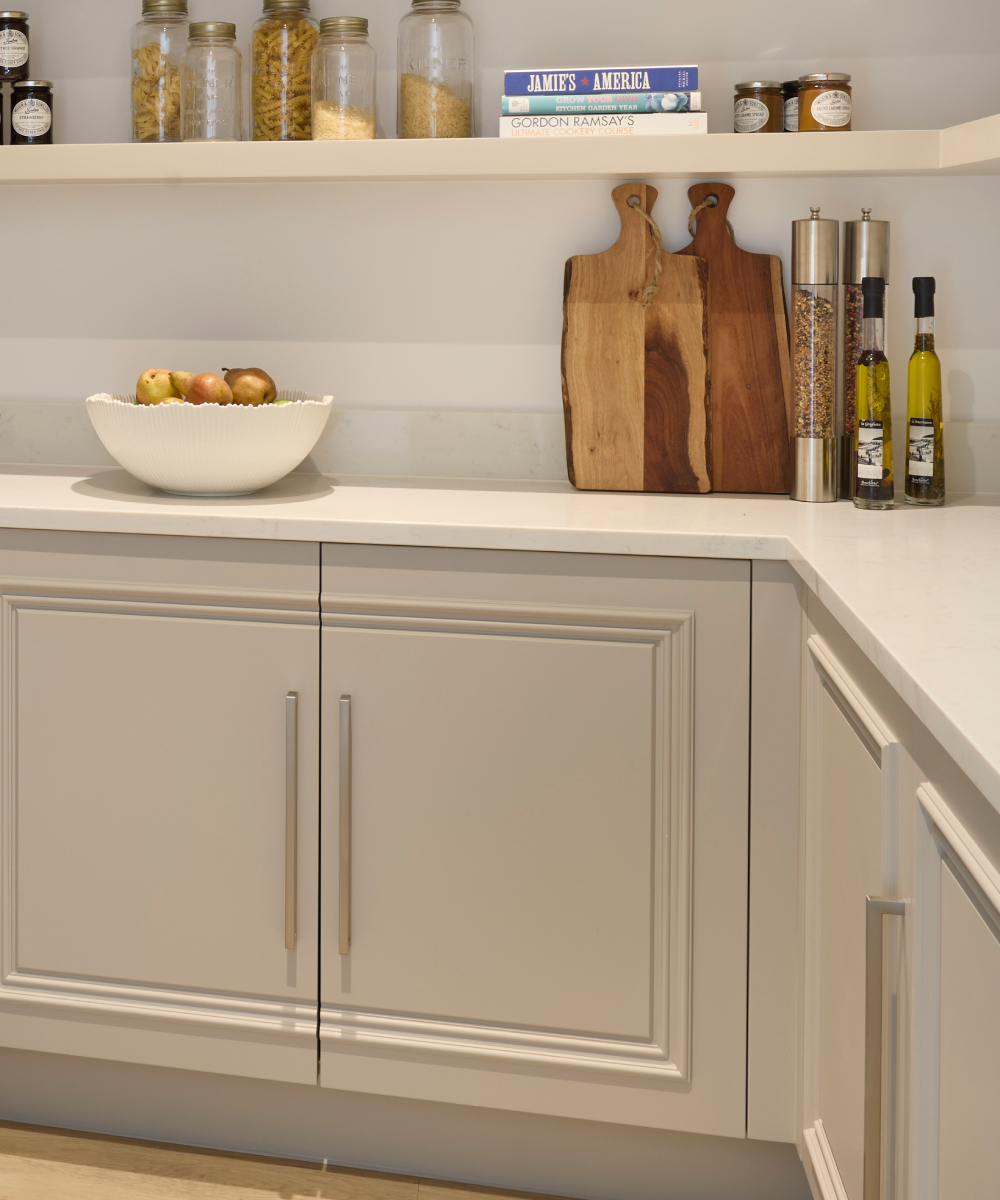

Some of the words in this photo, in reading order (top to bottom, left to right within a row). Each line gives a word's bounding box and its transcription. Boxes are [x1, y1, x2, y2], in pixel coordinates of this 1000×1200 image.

[406, 57, 467, 70] KILNER
[527, 73, 576, 92] JAMIE'S
[593, 71, 651, 91] AMERICA
[555, 96, 586, 104] GROW
[587, 95, 613, 103] YOUR
[615, 95, 638, 103] OWN
[555, 104, 586, 112] KITCHEN
[511, 117, 570, 128] GORDON
[573, 115, 635, 127] RAMSAY'S
[511, 128, 550, 137] ULTIMATE
[553, 127, 596, 136] COOKERY
[598, 126, 634, 135] COURSE
